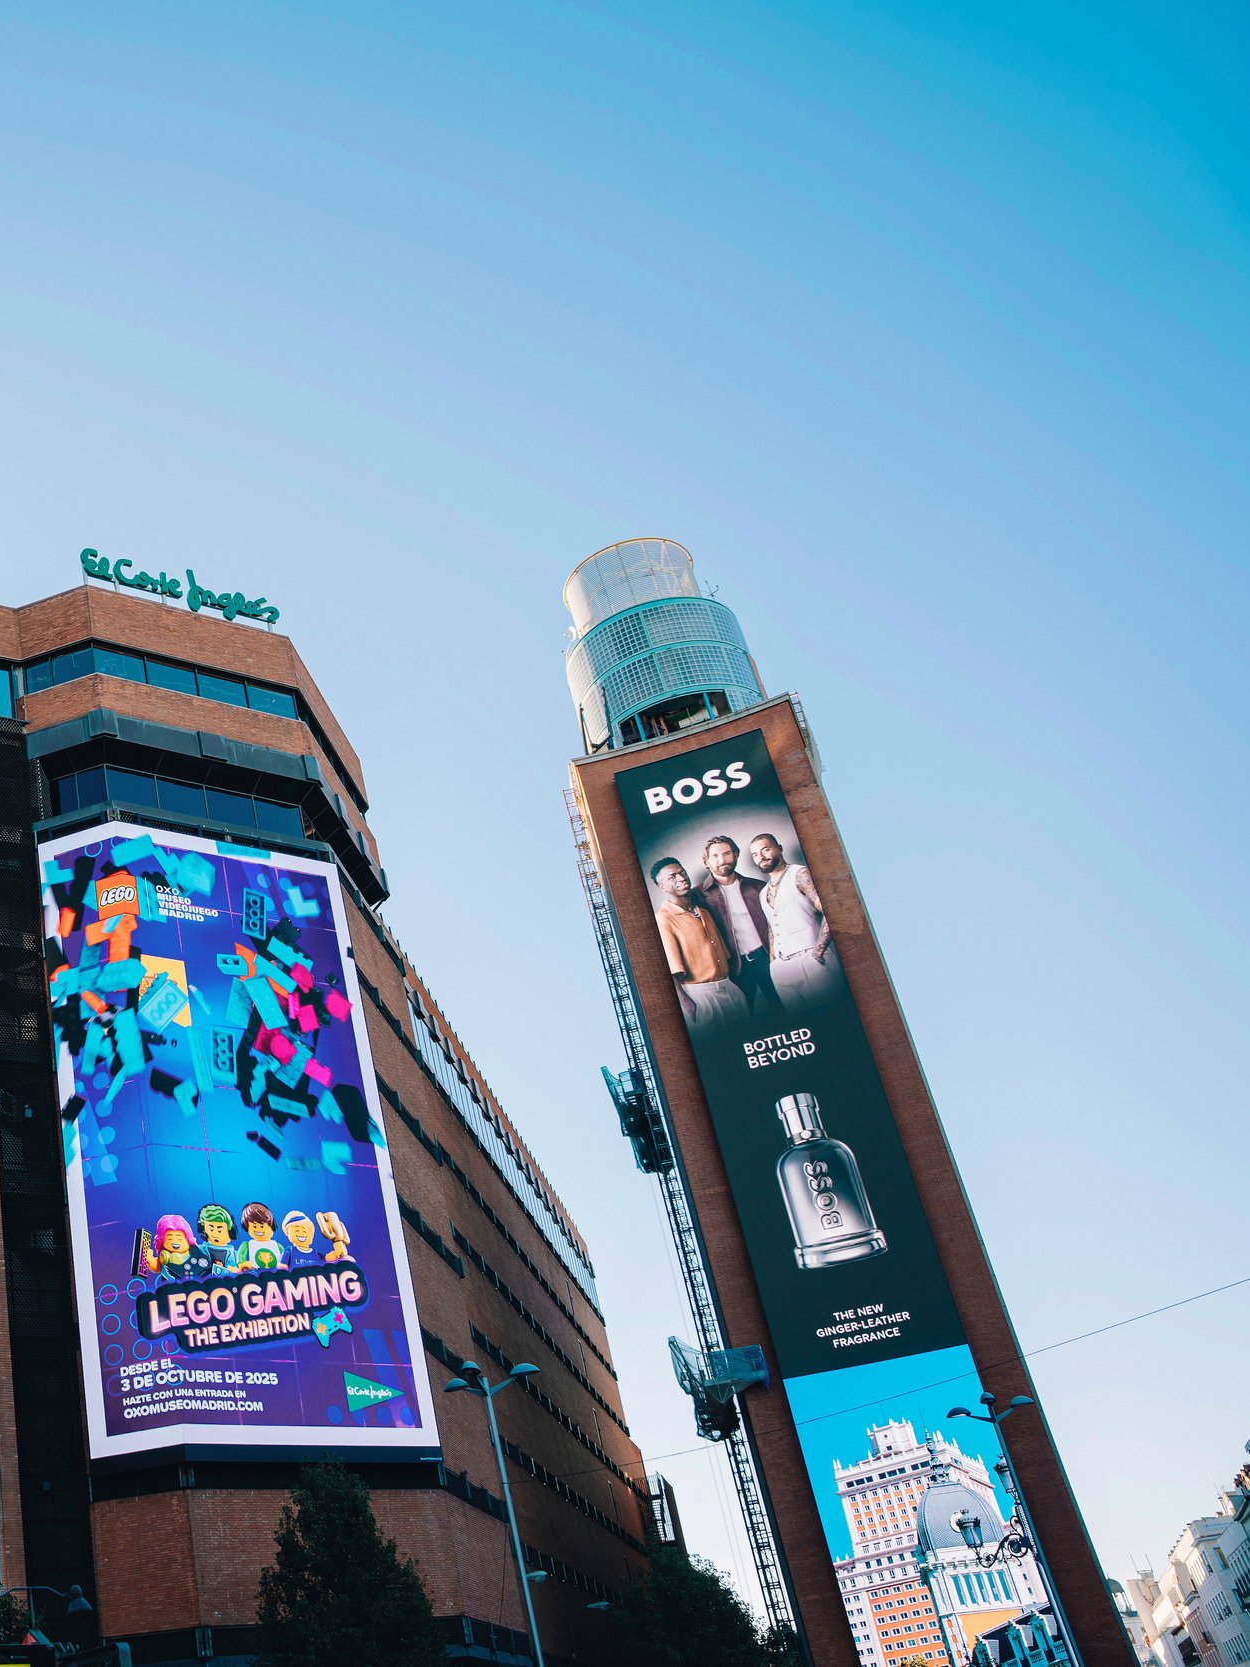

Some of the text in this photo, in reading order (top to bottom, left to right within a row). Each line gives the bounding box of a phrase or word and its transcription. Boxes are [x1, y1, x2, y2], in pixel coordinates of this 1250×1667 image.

[80, 548, 280, 622] El Corte Inglés
[643, 761, 751, 814] BOSS
[100, 885, 135, 907] LEGO
[155, 885, 179, 896] OXO
[156, 893, 191, 906] MUSEO
[158, 901, 219, 918] VIDEOJUEGO
[159, 908, 205, 922] MADRID
[743, 1028, 811, 1054] BOTTLED
[747, 1042, 815, 1069] BEYOND
[803, 1160, 844, 1230] BOSS
[149, 1270, 362, 1334] LEGO GAMING
[833, 1303, 884, 1321] THE NEW
[184, 1312, 311, 1348] THE EXHIBITION
[816, 1311, 911, 1337] GINGER-LEATHER
[832, 1327, 901, 1349] FRAGRANCE
[120, 1358, 175, 1377] DESDE EL
[121, 1369, 279, 1392] 3 DE OCTUBRE DE 2025
[122, 1388, 246, 1406] HAZTE CON UNA ENTRADA EN
[123, 1399, 264, 1419] OXOMUSEOMADRID.COM
